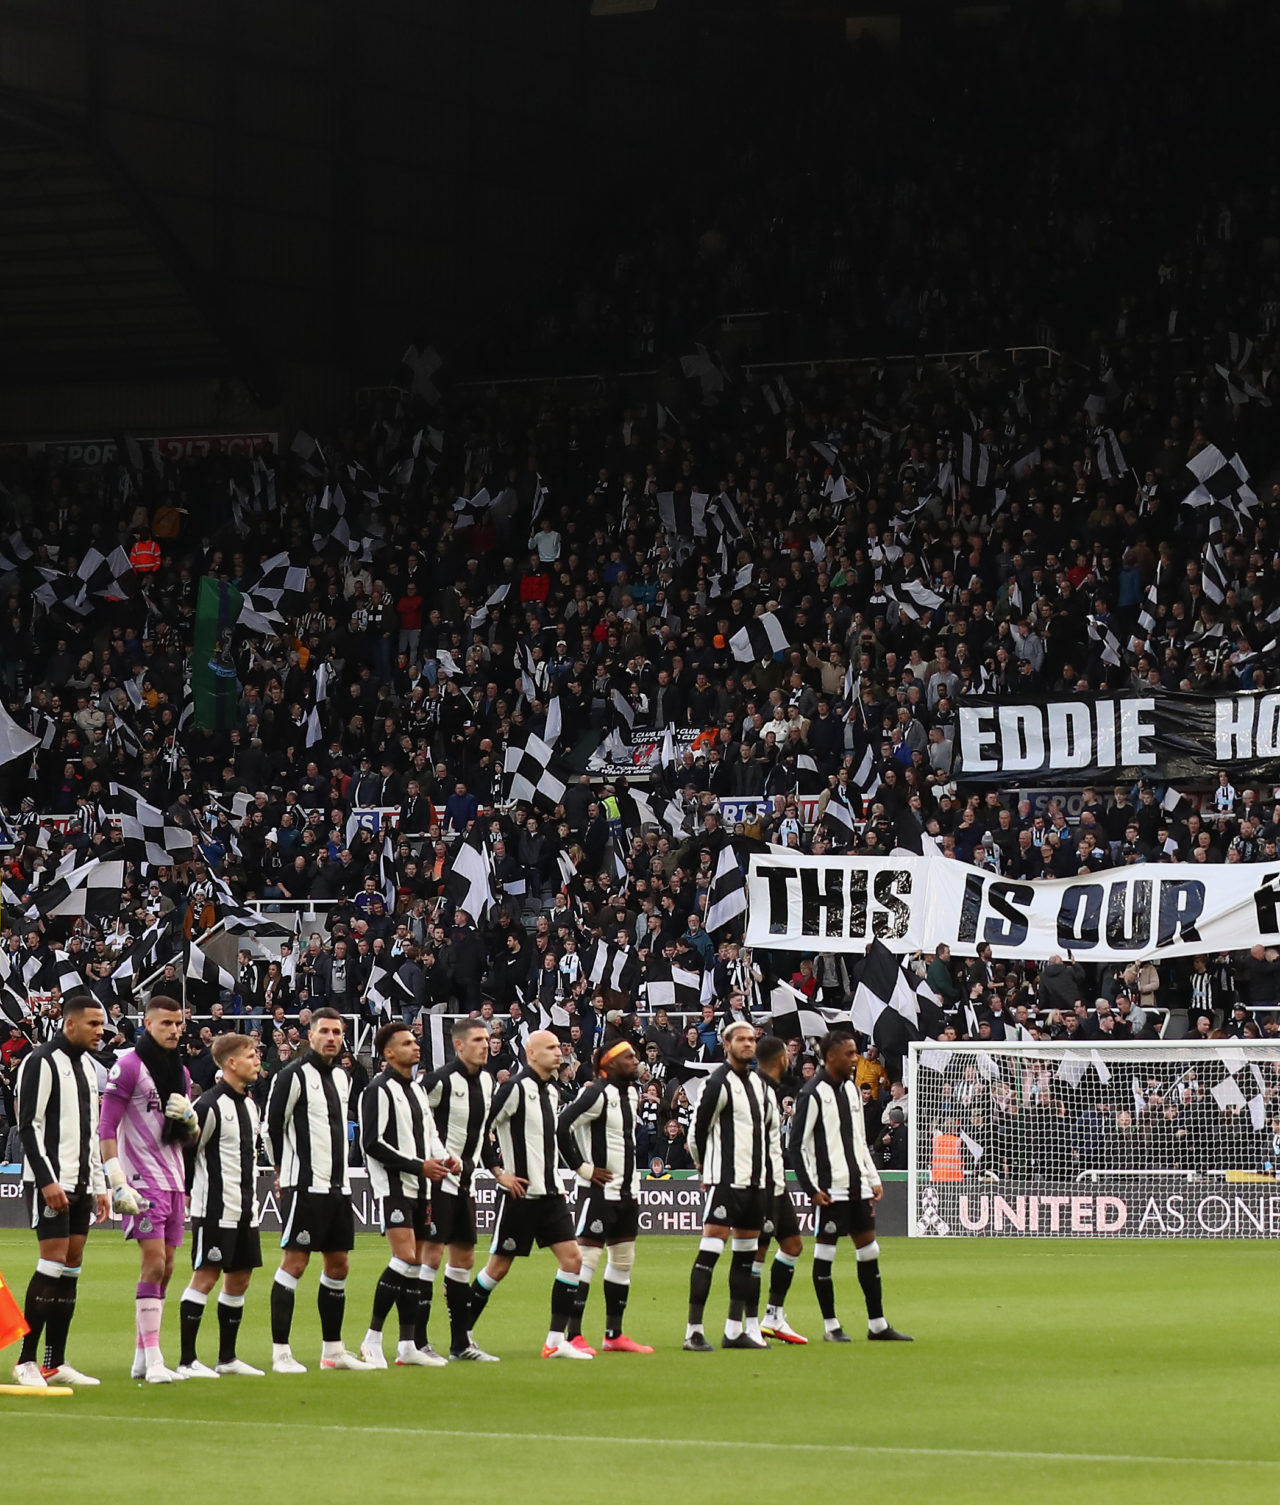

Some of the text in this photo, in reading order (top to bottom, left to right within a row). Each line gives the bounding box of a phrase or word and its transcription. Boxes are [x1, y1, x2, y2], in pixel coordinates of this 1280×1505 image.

[959, 698, 1156, 772] EDDIE
[756, 866, 911, 939] THIS
[957, 873, 1035, 946] IS
[1056, 879, 1206, 950] OUR
[677, 1190, 701, 1205] OR
[959, 1195, 1128, 1232] UNITED
[1138, 1196, 1183, 1232] AS
